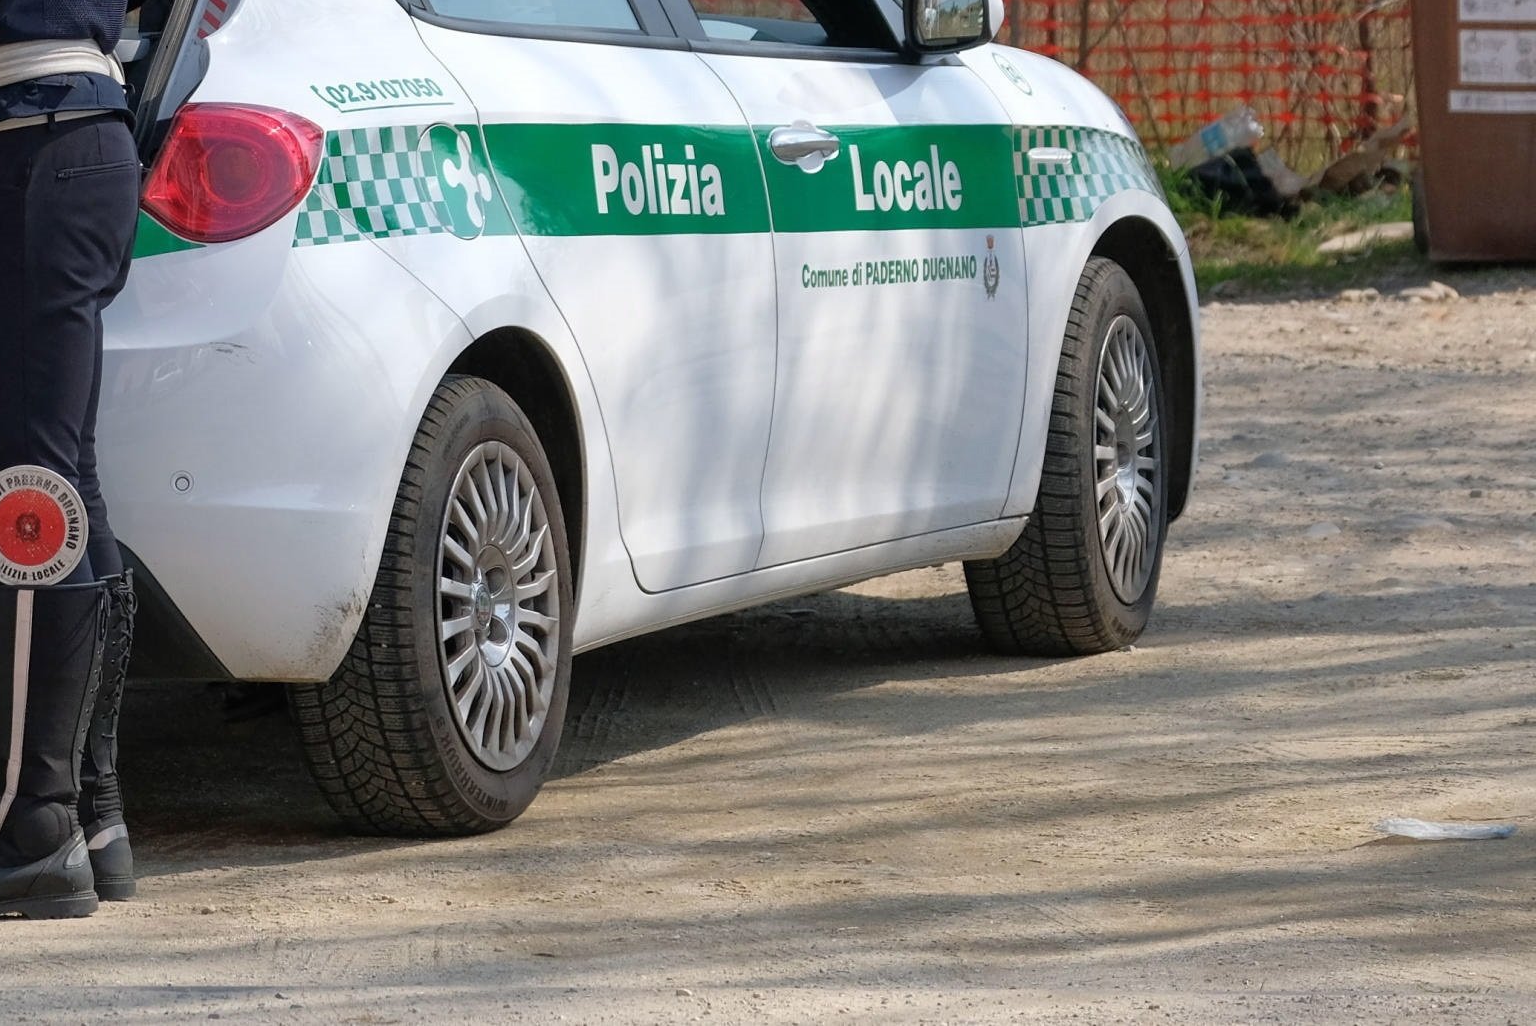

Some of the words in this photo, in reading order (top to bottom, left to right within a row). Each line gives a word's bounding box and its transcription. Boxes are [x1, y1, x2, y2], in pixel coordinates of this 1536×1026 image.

[325, 78, 444, 104] 02.9107050
[590, 143, 726, 217] Polizia
[848, 144, 963, 212] Locale
[801, 263, 849, 289] Comune
[851, 261, 863, 287] di
[865, 258, 919, 285] PADERNO
[922, 255, 978, 281] DUGNANO
[57, 492, 80, 551] DUGNANO
[31, 559, 66, 582] LOCALE
